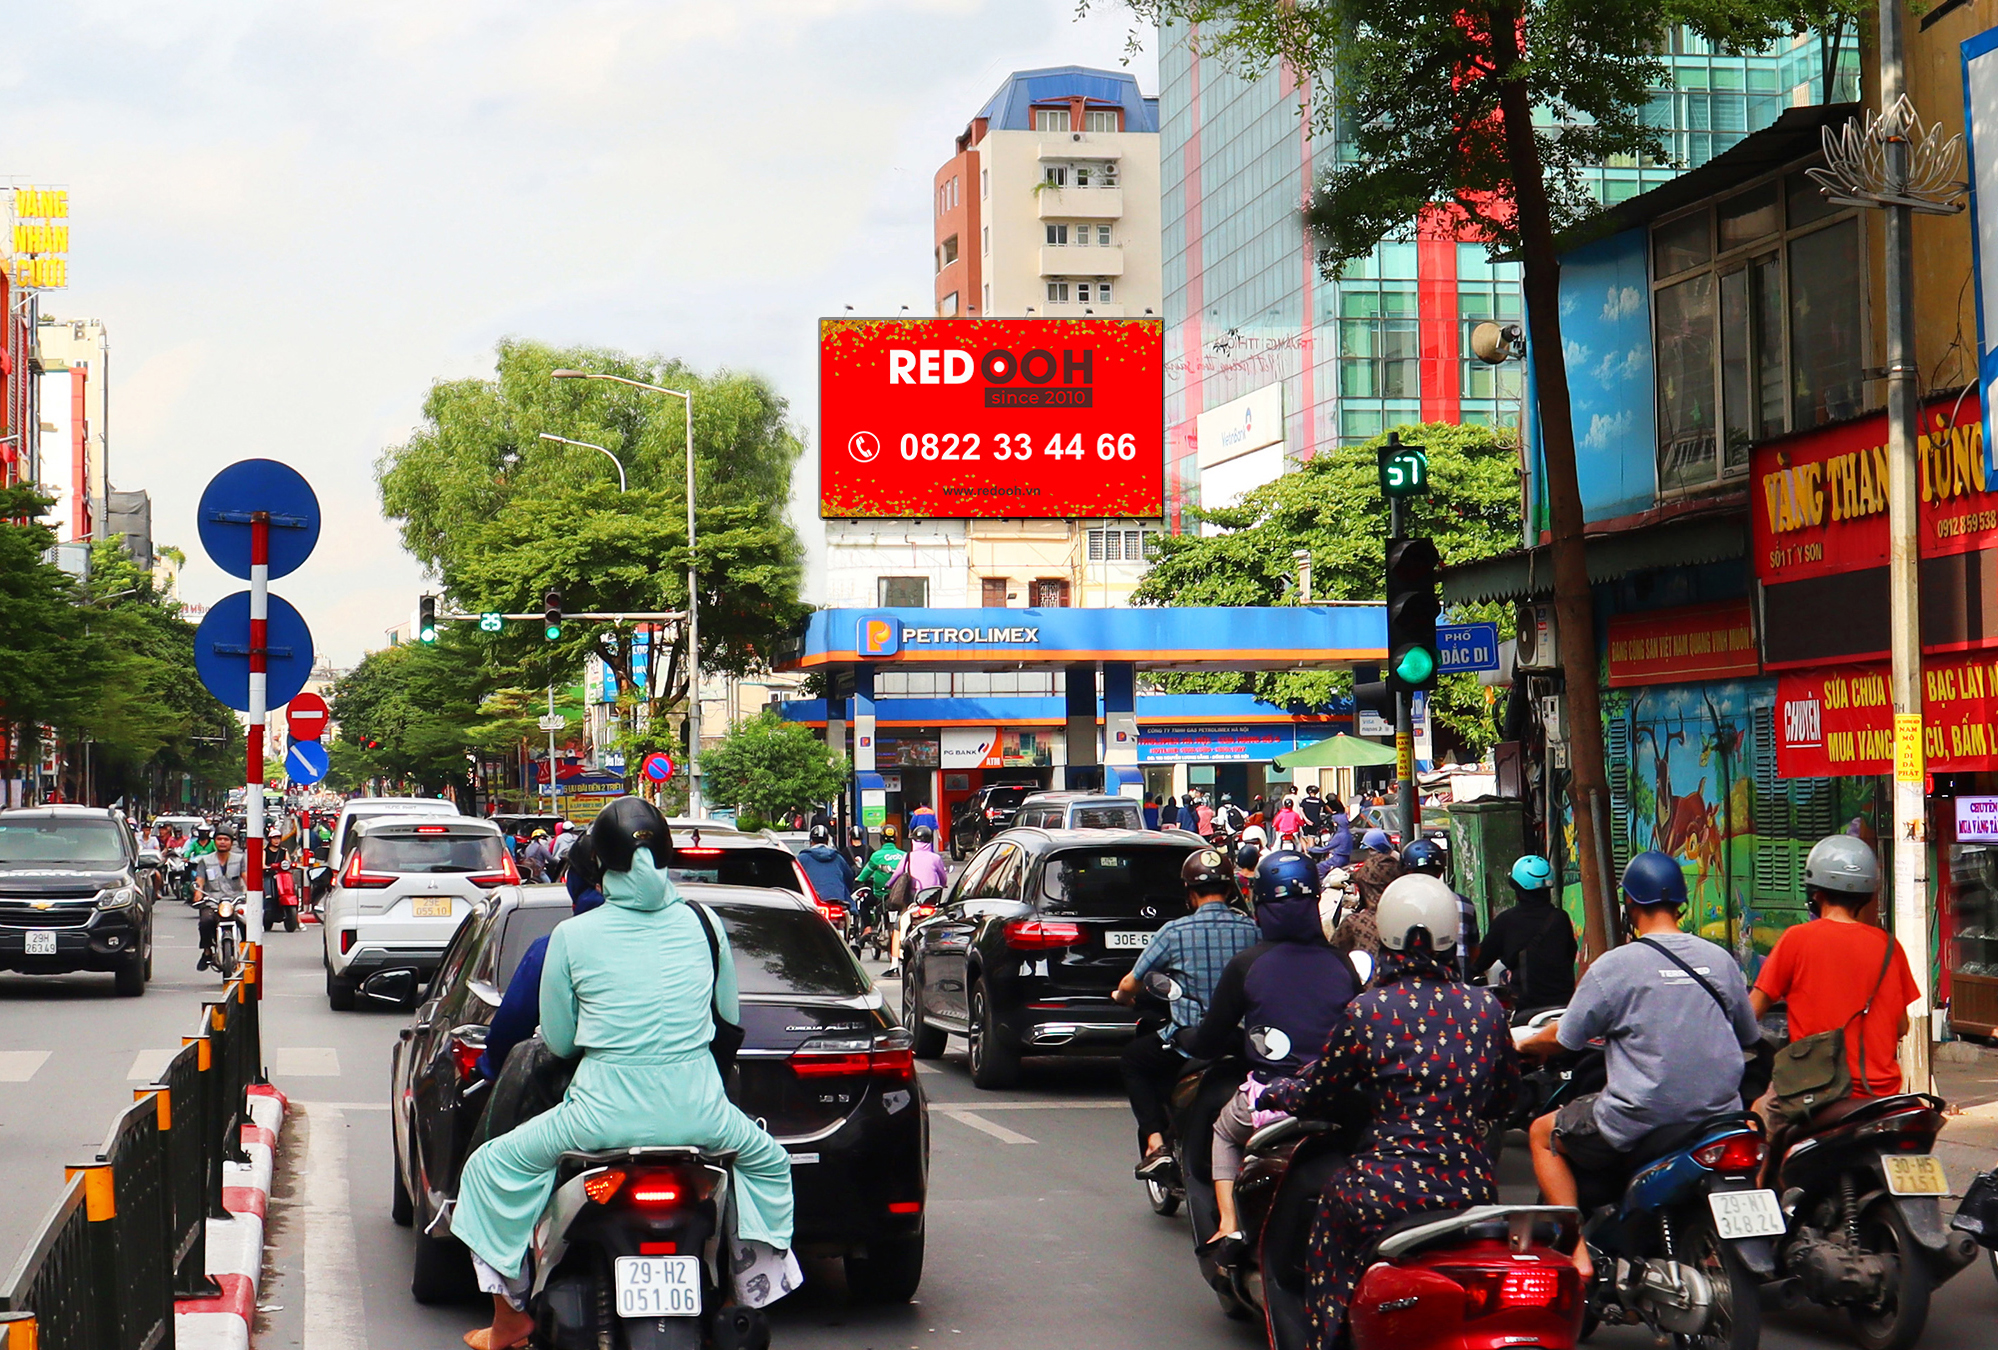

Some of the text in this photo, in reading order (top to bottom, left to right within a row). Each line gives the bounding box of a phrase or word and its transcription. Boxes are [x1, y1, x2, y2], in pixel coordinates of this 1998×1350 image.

[15, 185, 68, 218] VÀNG
[890, 349, 1093, 384] RED OOH
[991, 391, 1086, 404] since 2010
[900, 433, 1136, 461] 0822 33 44 66
[1763, 452, 1823, 534] VÀNG
[1918, 413, 1986, 502] TÙNG
[942, 485, 1041, 496] www.redooh.vn
[1937, 509, 1997, 538] 0912 859 538
[1804, 542, 1822, 563] SƠN
[481, 613, 501, 630] 25
[902, 627, 1039, 643] PETROLIMEX
[1445, 628, 1471, 642] PHỐ
[1673, 634, 1689, 656] NAM
[1441, 643, 1489, 665] ĐẮC DI
[1851, 671, 1887, 708] CHỮA
[1926, 669, 1956, 708] BẠC
[1958, 658, 1984, 699] LẤY
[1784, 691, 1822, 742] CHUYÊN
[1827, 731, 1855, 762] MUA
[1857, 723, 1893, 761] VÀNG
[1951, 712, 1987, 757] BẤM
[1902, 734, 1914, 742] MÔ
[986, 757, 1000, 765] ATM
[1898, 769, 1919, 778] PHẬT
[884, 853, 903, 861] Grab
[416, 907, 447, 915] 055.10
[33, 934, 49, 943] 29H
[629, 1261, 686, 1284] 29-H2
[624, 1288, 694, 1311] 051.06
